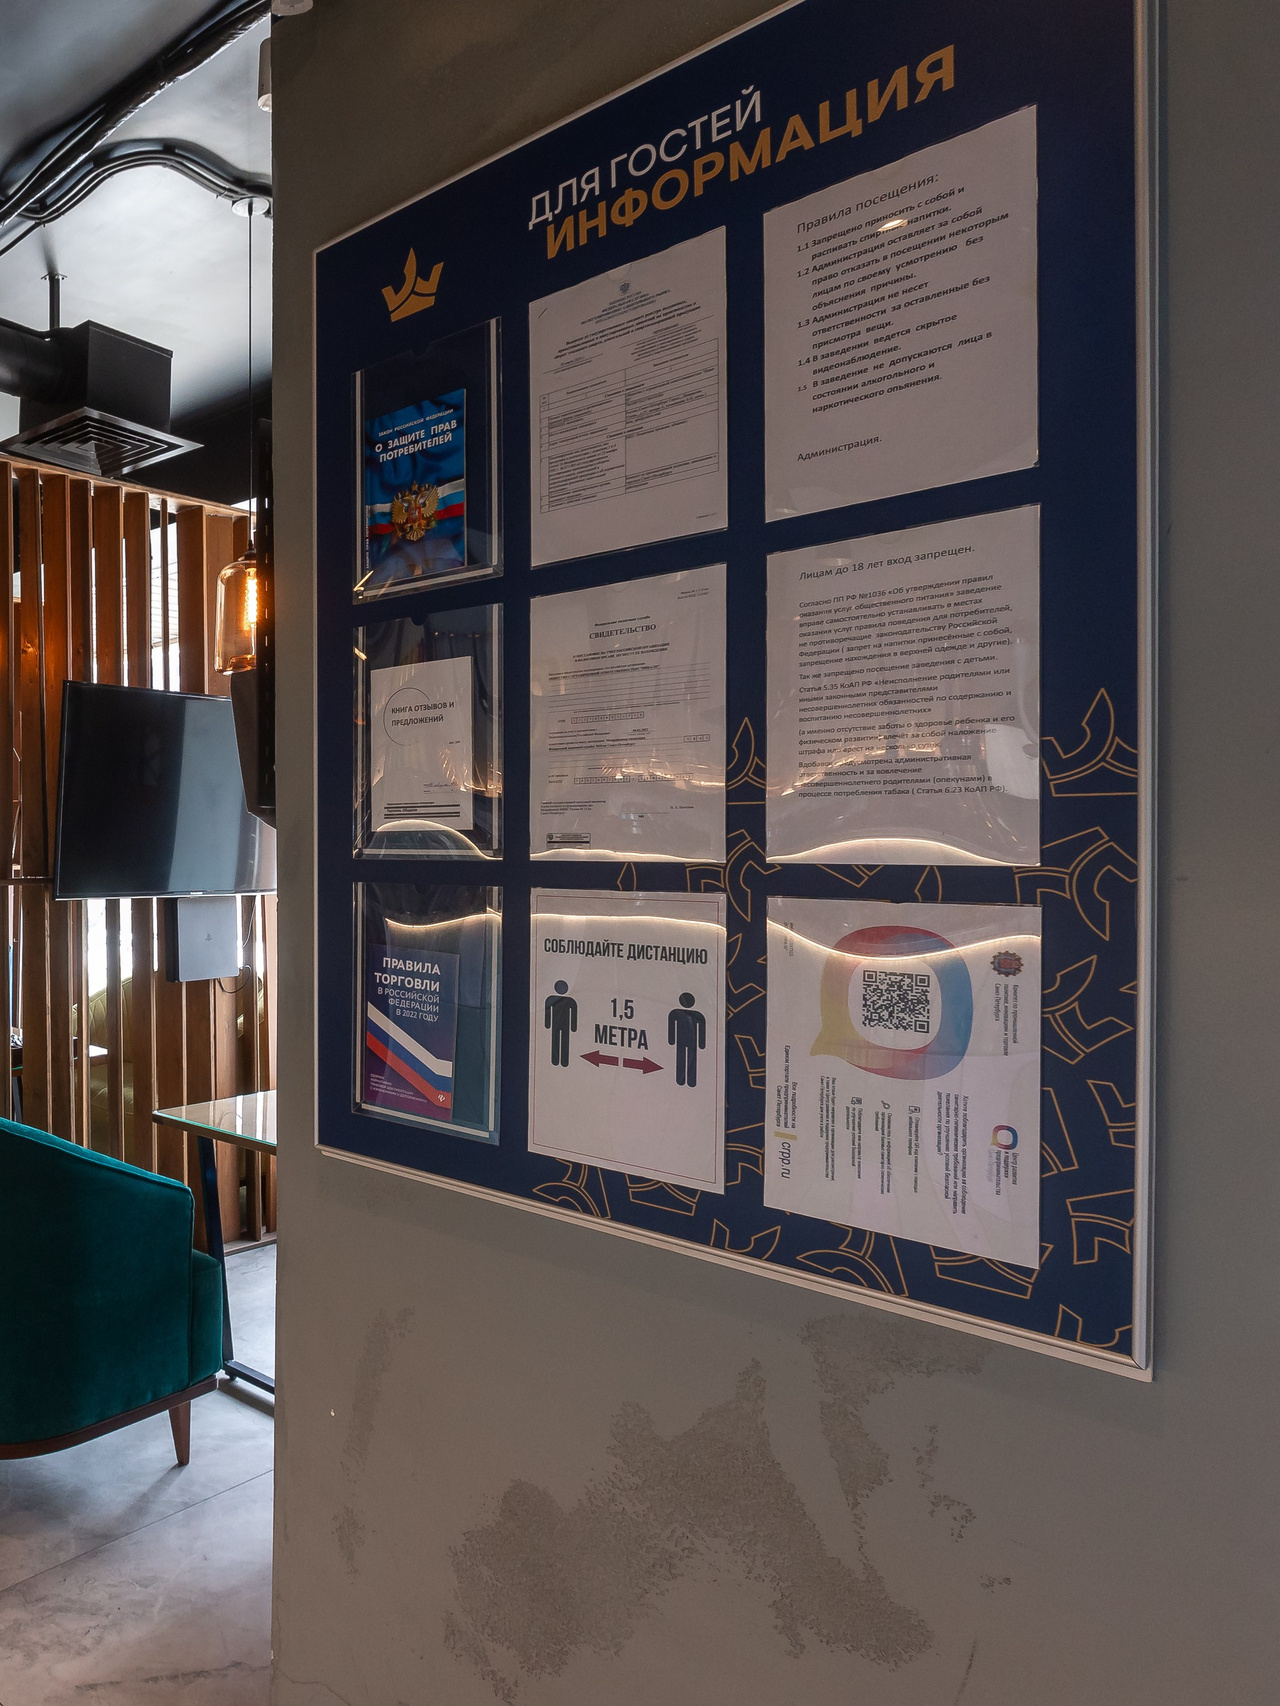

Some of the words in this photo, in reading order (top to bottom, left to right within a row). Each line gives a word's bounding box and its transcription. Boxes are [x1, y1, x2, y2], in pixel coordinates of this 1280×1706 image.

[528, 167, 600, 230] ДЛЯ
[611, 85, 761, 188] ГОСТЕЙ
[547, 44, 955, 260] ИНФОРМАЦИЯ
[797, 206, 851, 235] Правила
[855, 173, 938, 213] посещения:
[797, 241, 809, 252] 1.1
[811, 222, 862, 248] Запрещено
[864, 203, 915, 229] приносить
[924, 187, 955, 207] собой
[797, 267, 809, 278] 1.2
[811, 240, 885, 274] Администрация
[887, 223, 935, 246] оставляет
[950, 205, 982, 225] собой
[811, 238, 857, 261] распивать
[906, 201, 951, 225] напитки.
[811, 271, 838, 287] право
[840, 257, 880, 276] отказать
[890, 234, 946, 259] посещении
[948, 212, 1008, 240] некоторым
[811, 283, 841, 299] лицам
[856, 266, 891, 284] своему
[895, 243, 957, 271] усмотрению
[965, 233, 983, 246] без
[797, 318, 809, 328] 1.3
[811, 294, 885, 325] Администрация
[901, 281, 929, 295] несет
[811, 286, 865, 313] объяснения
[870, 271, 916, 293] причины.
[811, 308, 886, 337] ответственности
[903, 282, 969, 308] оставленные
[971, 273, 990, 288] без
[797, 356, 810, 368] 1.4
[820, 340, 868, 361] заведении
[873, 328, 910, 345] ведется
[915, 314, 957, 333] скрытое
[812, 329, 860, 351] присмотра
[865, 319, 893, 334] вещи.
[812, 342, 901, 376] видеонаблюдение.
[820, 366, 868, 387] заведение
[888, 340, 952, 367] допускаются
[956, 333, 983, 348] лица
[812, 382, 858, 402] состоянии
[860, 362, 925, 389] алкогольного
[812, 389, 884, 415] наркотического
[886, 373, 941, 393] опьянения.
[375, 443, 383, 453] О
[387, 430, 425, 450] ЗАЩИТЕ
[430, 419, 457, 436] ПРАВ
[379, 432, 452, 463] ПОТРЕБИТЕЛЕЙ
[796, 433, 881, 463] Администрация.
[799, 567, 832, 581] Лицам
[835, 564, 848, 576] до
[852, 562, 863, 573] 18
[867, 560, 883, 569] лет
[887, 555, 911, 567] вход
[915, 545, 975, 563] запрещен.
[589, 622, 656, 640] СВИДЕТЕЛЬСТВО
[391, 704, 413, 714] КНИГА
[414, 701, 447, 713] ОТЗЫВОВ
[448, 701, 455, 709] И
[391, 714, 444, 727] ПРЕДЛОЖЕНИЙ
[382, 957, 441, 976] ПРАВИЛА
[544, 938, 624, 958] СОБЛЮДАЙТЕ
[626, 943, 708, 965] ДИСТАНЦИЮ
[374, 972, 440, 992] ТОРГОВЛИ
[377, 986, 383, 995] В
[384, 987, 440, 1004] РОССИЙСКОЙ
[388, 998, 439, 1013] ФЕДЕРАЦИИ
[396, 1008, 401, 1016] В
[402, 1009, 417, 1019] 2022
[418, 1012, 439, 1023] ГОДУ
[610, 997, 634, 1022] 1,5
[594, 1023, 648, 1050] МЕТРА
[778, 1140, 791, 1179] crpp.ru
